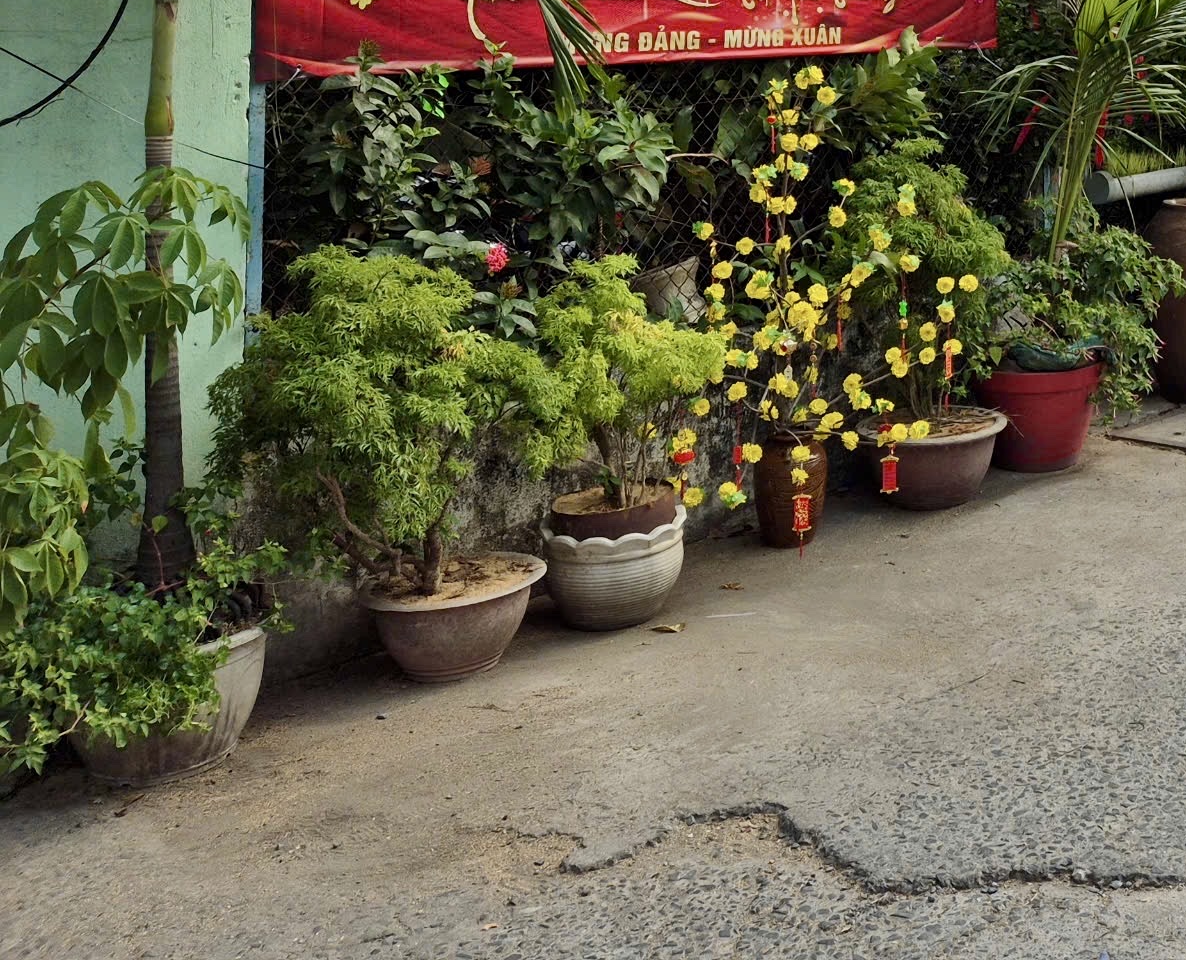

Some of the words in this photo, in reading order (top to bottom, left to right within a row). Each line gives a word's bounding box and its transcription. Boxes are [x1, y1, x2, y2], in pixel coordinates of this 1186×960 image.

[638, 25, 700, 52] ĐẢNG
[723, 26, 784, 49] MỪNG
[791, 24, 842, 46] XUÂN
